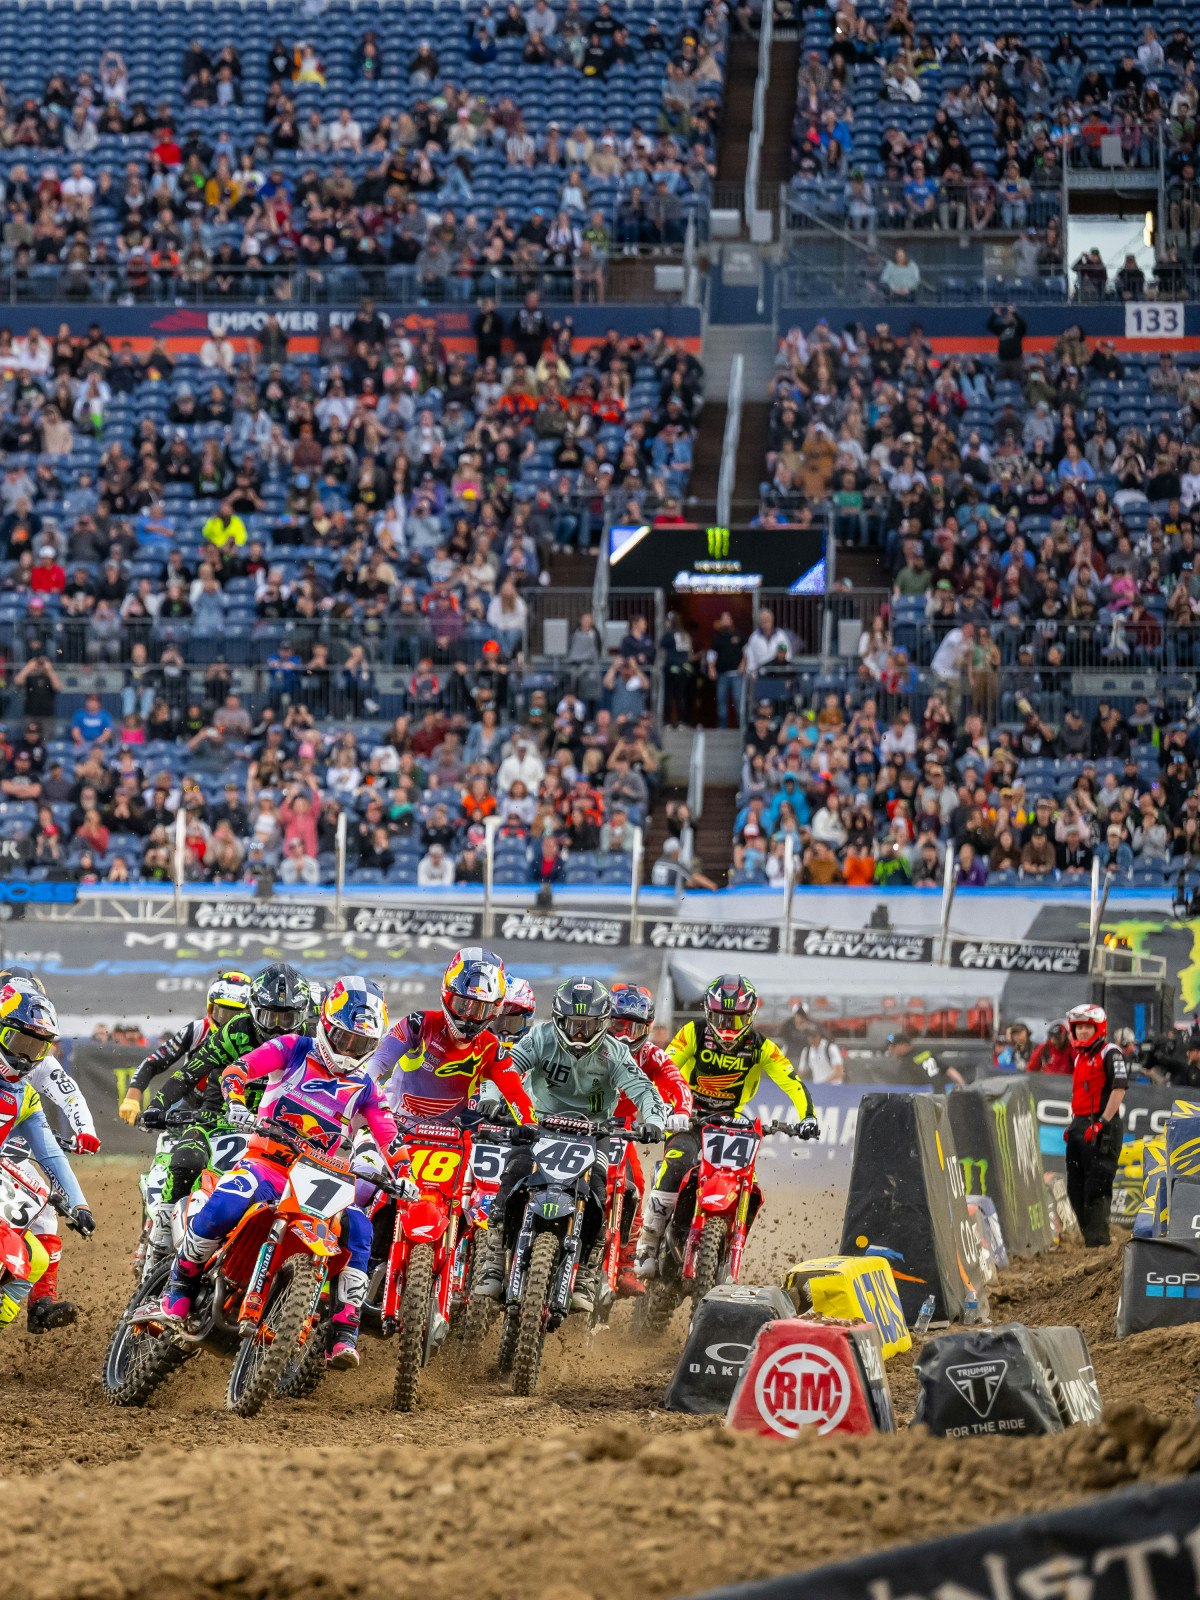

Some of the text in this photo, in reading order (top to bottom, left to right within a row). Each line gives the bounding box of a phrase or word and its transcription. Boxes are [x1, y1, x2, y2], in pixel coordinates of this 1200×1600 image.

[1132, 307, 1179, 332] 133
[542, 1061, 571, 1084] 46
[701, 1049, 749, 1071] O'NEAL
[418, 1124, 457, 1132] RENTHAL
[547, 1116, 599, 1131] RENTHAL
[309, 1152, 345, 1171] RENTHAL
[536, 1142, 590, 1175] 46
[707, 1135, 751, 1167] 14
[411, 1150, 461, 1183] 18
[304, 1178, 343, 1212] 1
[252, 1252, 273, 1295] DUNLOP
[556, 1253, 574, 1302] DUNLOP
[956, 1365, 997, 1377] TRIUMPH
[775, 1371, 832, 1411] RM
[945, 1418, 1026, 1439] FOR THE RIDE
